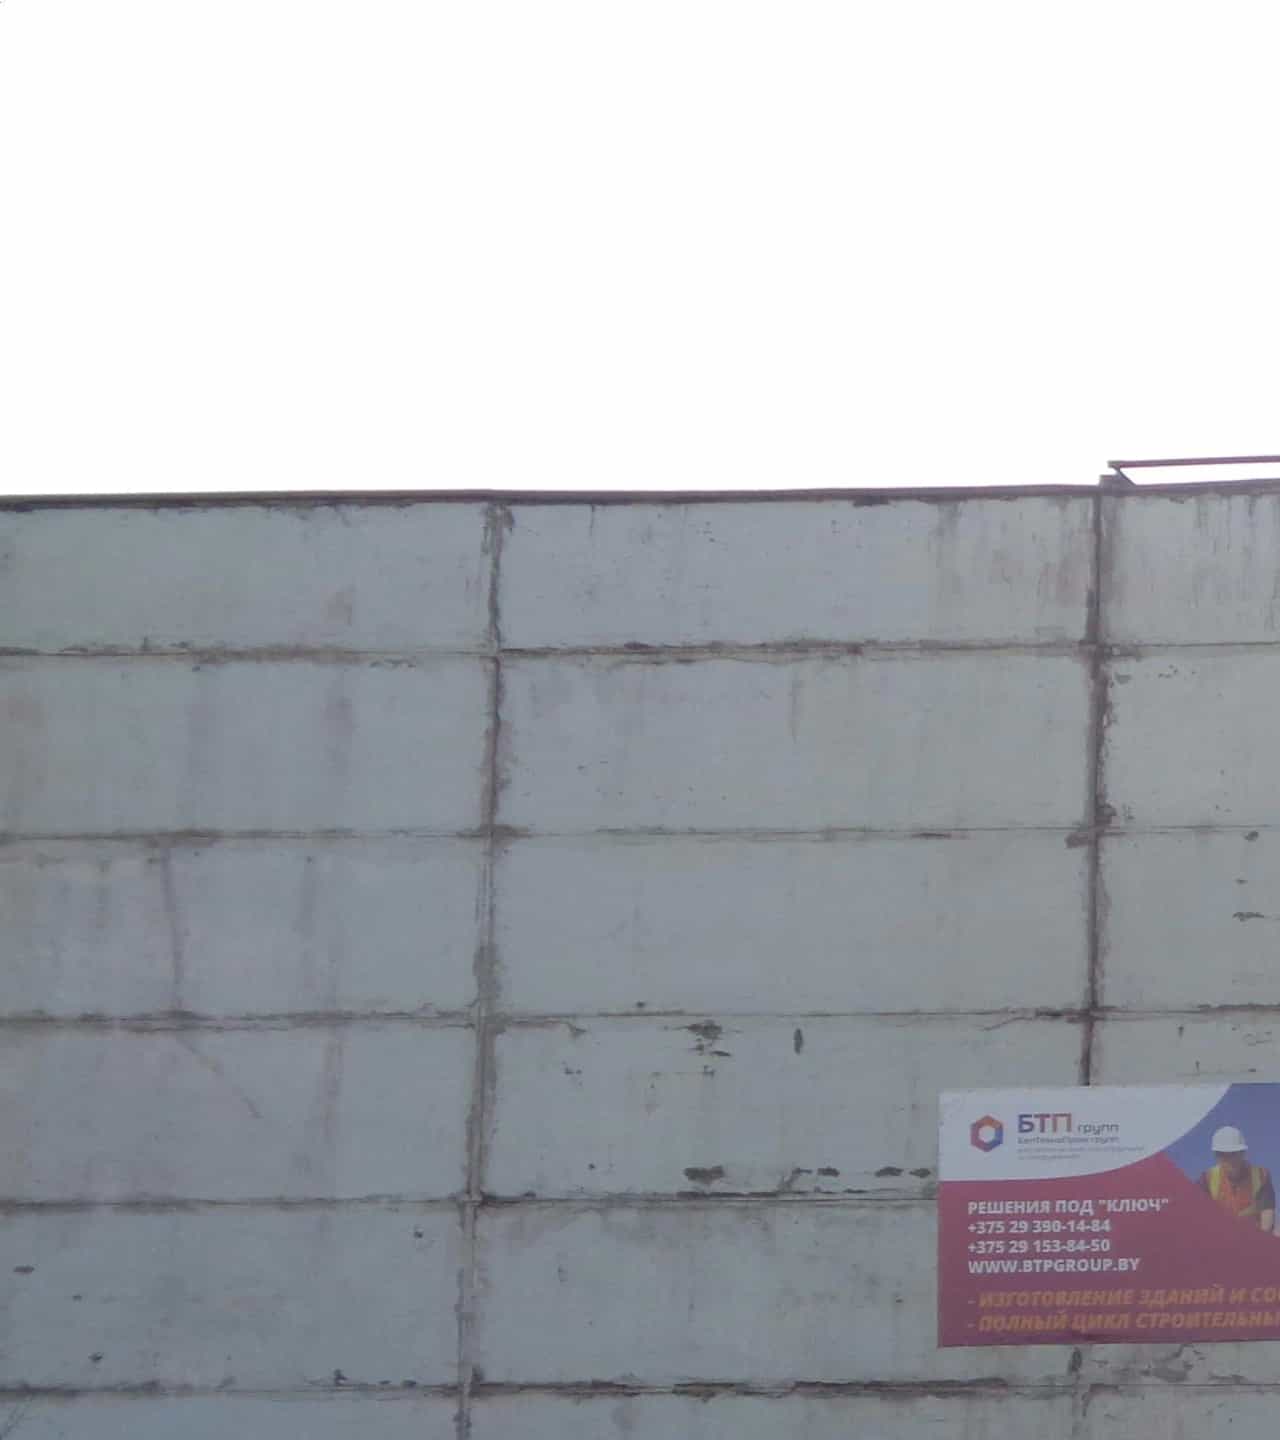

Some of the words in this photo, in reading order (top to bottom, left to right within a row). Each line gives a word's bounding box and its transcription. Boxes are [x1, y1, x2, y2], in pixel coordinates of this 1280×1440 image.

[1018, 1113, 1073, 1133] БТП
[1077, 1122, 1119, 1135] групп
[968, 1200, 1051, 1215] РЕШЕНИЯ
[1055, 1200, 1094, 1216] ПОД
[1098, 1198, 1169, 1213] "КЛЮЧ"
[968, 1220, 1006, 1234] +375
[1009, 1220, 1028, 1233] 29
[1032, 1219, 1112, 1233] 390-14-84
[968, 1240, 1006, 1254] +375
[1009, 1240, 1028, 1254] 29
[1033, 1239, 1111, 1253] 153-84-50
[968, 1257, 1141, 1274] WWW.BTPGROUP.BY
[979, 1288, 1134, 1308] ИЗГОТОВЛЕНИЕ
[1137, 1283, 1225, 1309] ЗДАНИЙ
[1230, 1287, 1246, 1304] И
[979, 1310, 1066, 1333] ПОЛНЫЙ
[1071, 1312, 1129, 1333] ЦИКЛ
